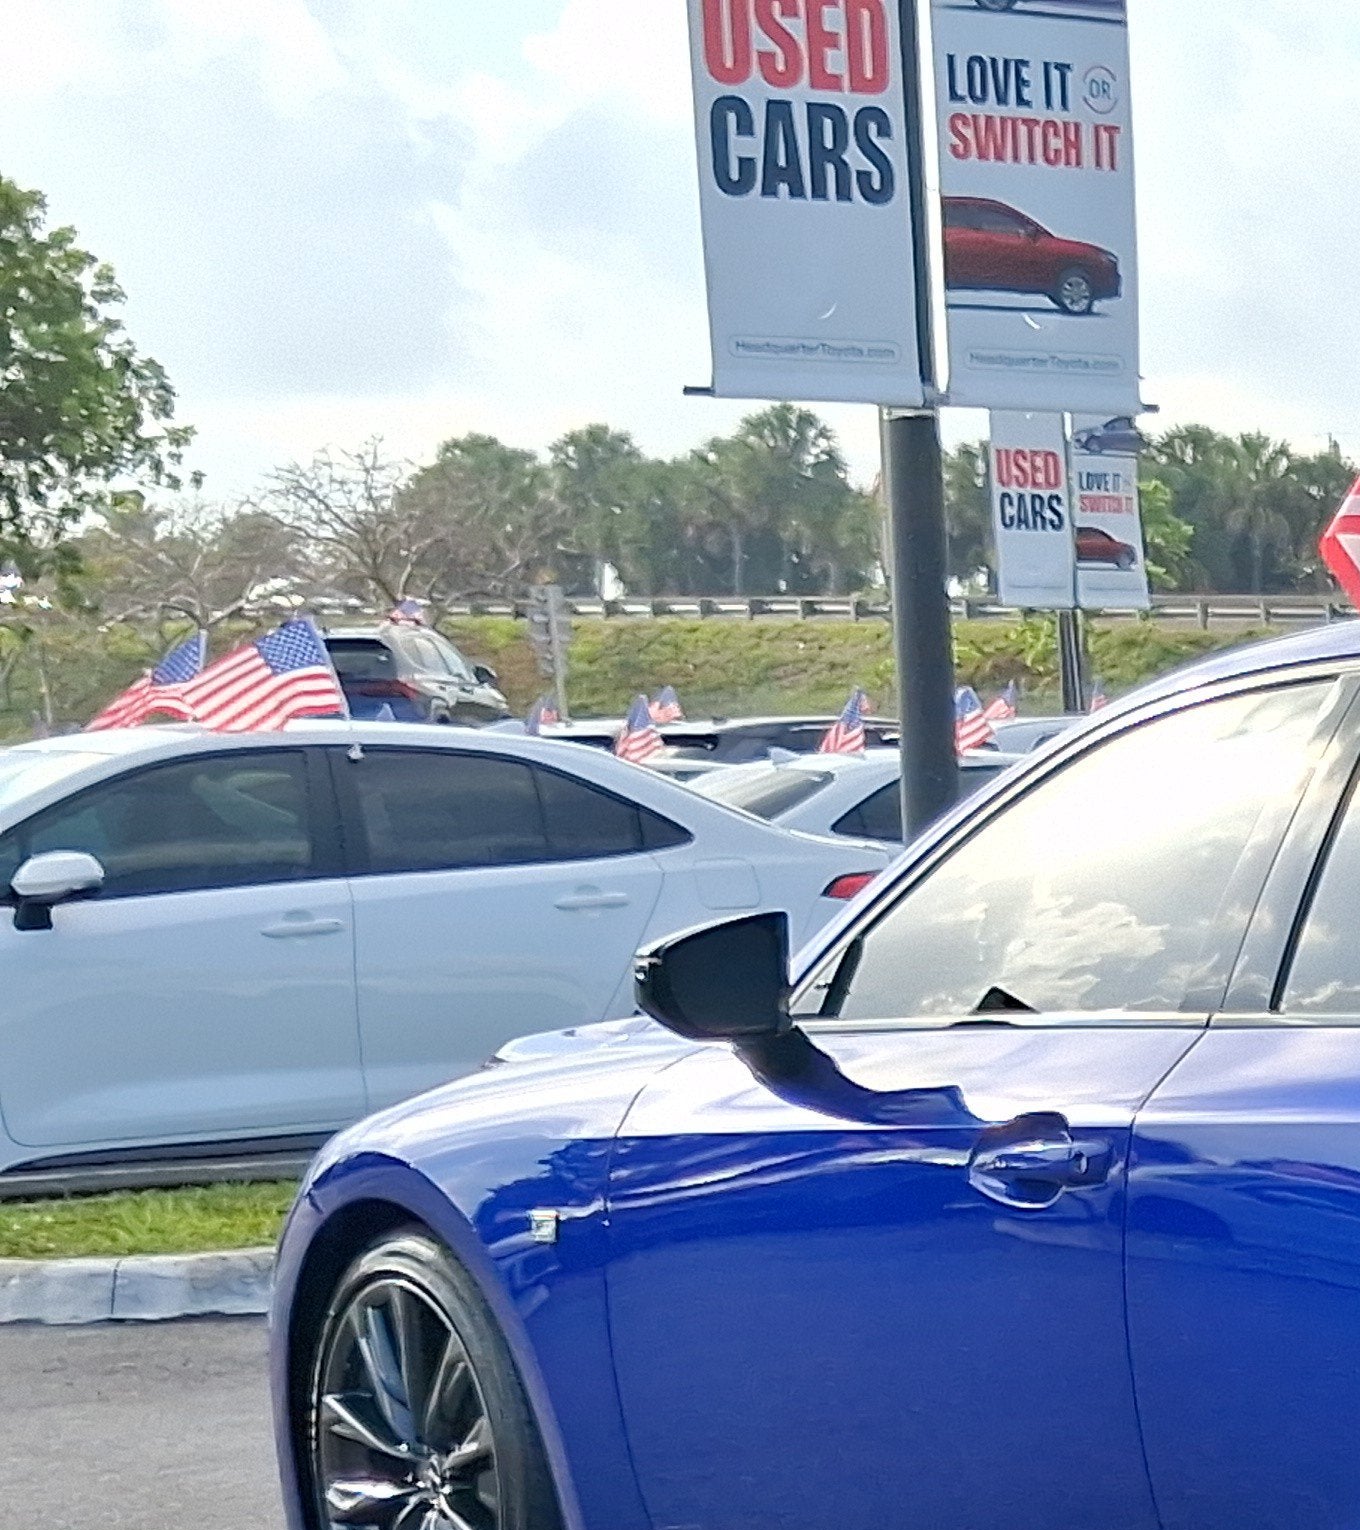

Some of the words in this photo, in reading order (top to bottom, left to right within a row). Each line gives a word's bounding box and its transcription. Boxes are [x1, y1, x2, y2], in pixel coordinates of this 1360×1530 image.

[702, 0, 890, 95] USED
[946, 52, 1031, 109] LOVE
[1043, 60, 1074, 112] IT
[1088, 77, 1112, 101] OR
[710, 94, 896, 206] CARS
[948, 111, 1082, 169] SWITCH
[1093, 124, 1122, 171] IT
[995, 448, 1062, 490] USED
[1079, 471, 1109, 492] LOVE
[1000, 492, 1065, 532] CARS
